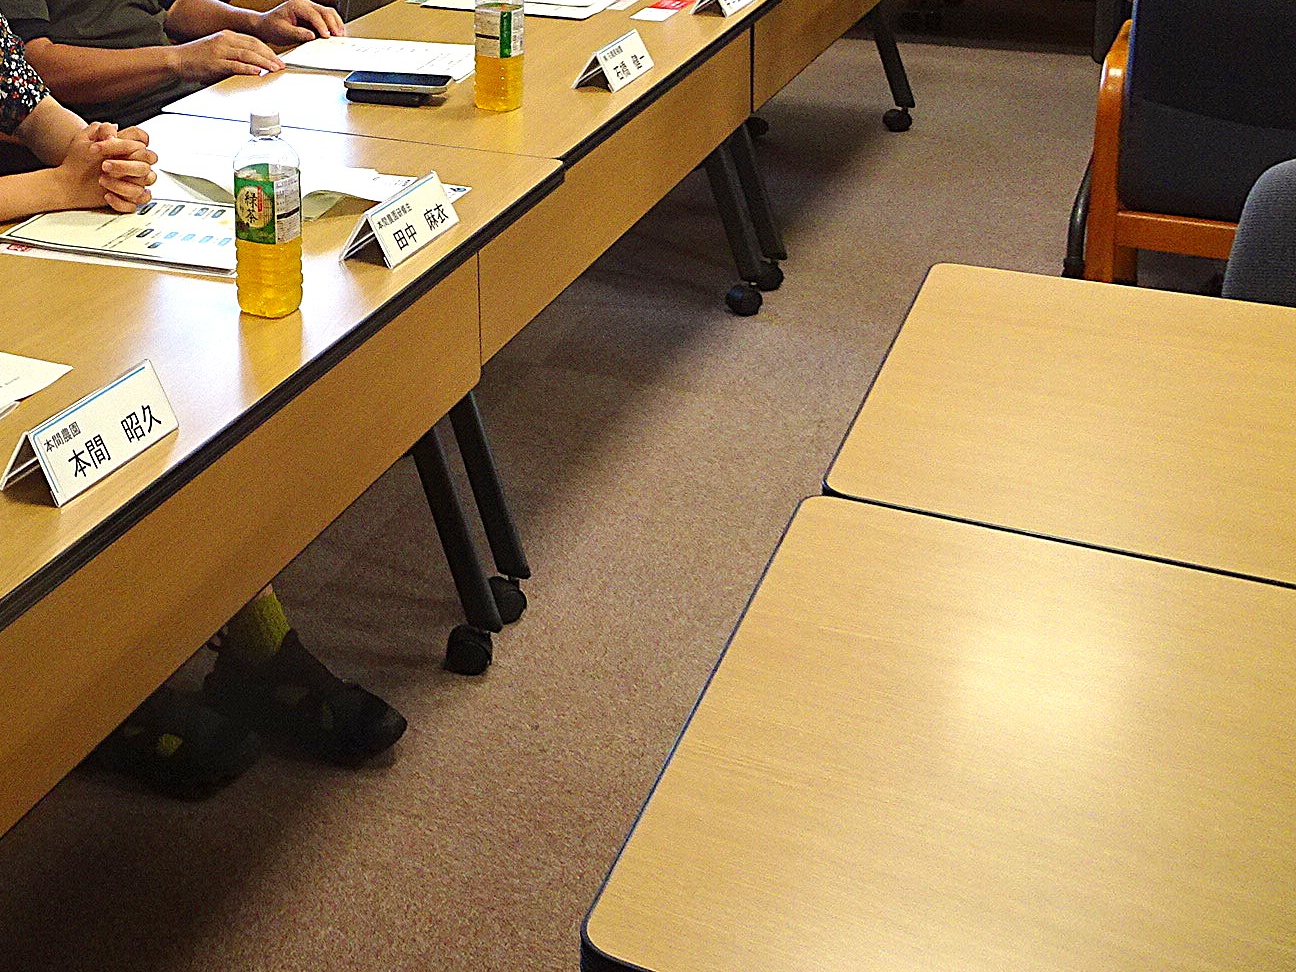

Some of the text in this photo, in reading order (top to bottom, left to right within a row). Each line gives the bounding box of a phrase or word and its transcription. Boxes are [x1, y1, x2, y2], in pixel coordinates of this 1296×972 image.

[244, 190, 259, 224] 緑茶
[392, 203, 449, 251] 田中 麻衣
[43, 421, 82, 453] 本間農園
[67, 404, 162, 478] 本間 昭久
